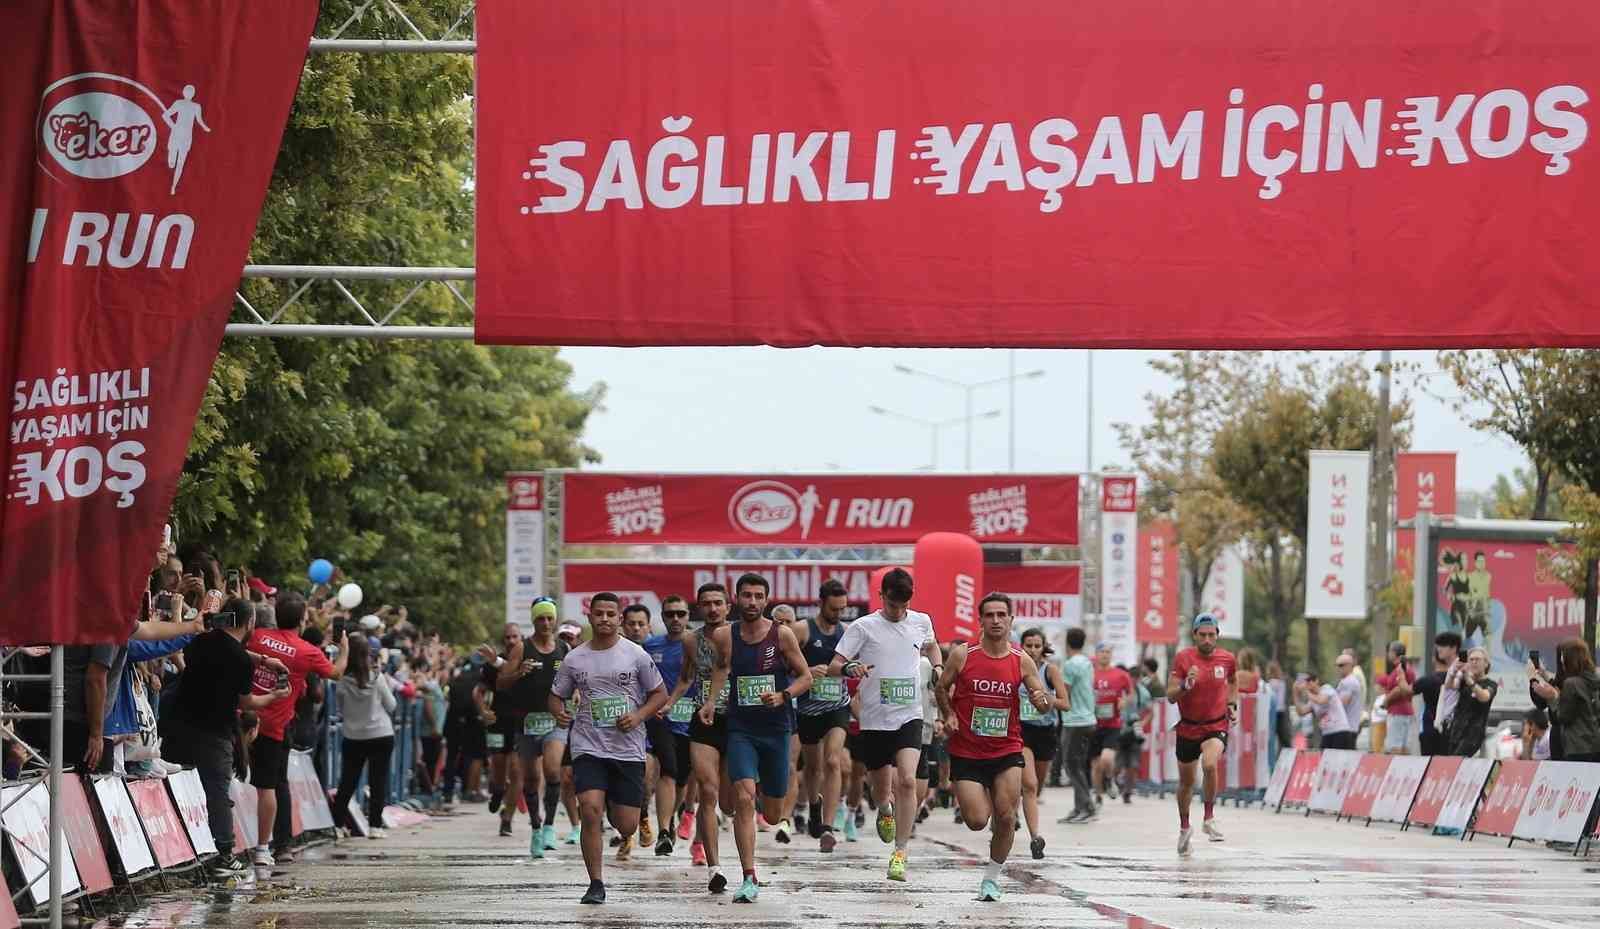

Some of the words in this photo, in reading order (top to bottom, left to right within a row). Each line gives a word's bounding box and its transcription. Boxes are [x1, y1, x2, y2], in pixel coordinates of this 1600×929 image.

[64, 120, 151, 161] eker
[519, 115, 896, 214] SAĞLIKLI
[910, 110, 1204, 213] YAŞAM
[1221, 84, 1382, 199] İÇİN
[1385, 85, 1589, 176] KOŞ
[27, 208, 48, 263] I
[12, 367, 150, 413] SAĞLIKLI
[11, 412, 92, 447] YAŞAM
[97, 402, 149, 440] İÇİN
[8, 440, 147, 508] KOŞ
[608, 507, 665, 536] KOŞ
[825, 498, 841, 528] I
[971, 508, 1029, 537] KOŞ
[1330, 473, 1347, 568] AFEKS
[1015, 598, 1064, 618] NISH
[1531, 595, 1585, 631] RİTM
[261, 637, 295, 656] AKUT
